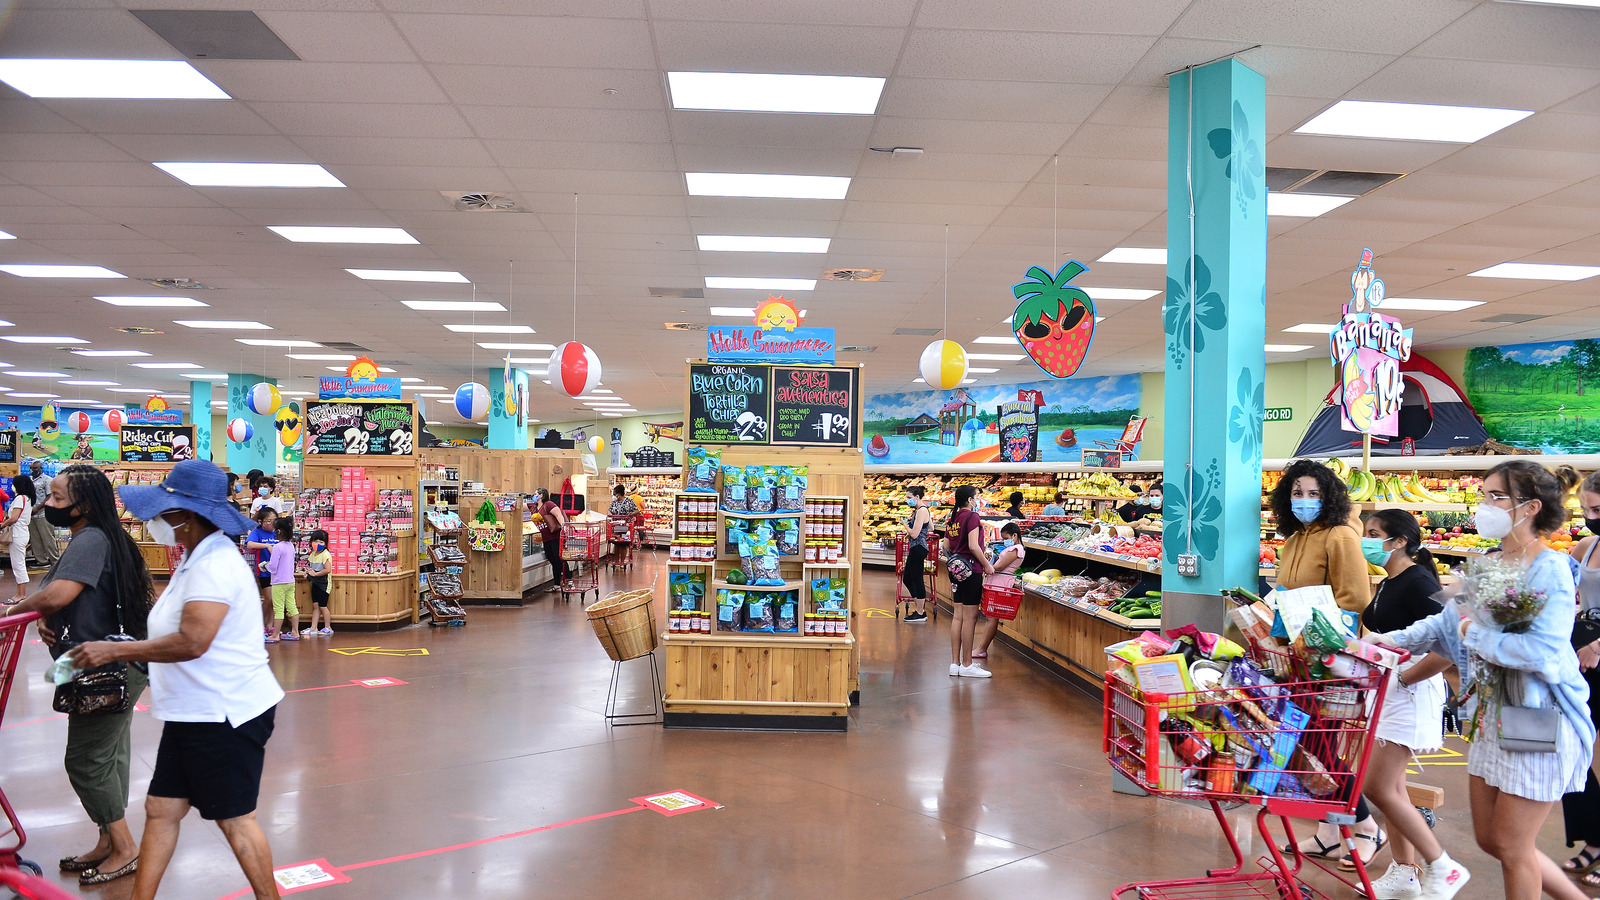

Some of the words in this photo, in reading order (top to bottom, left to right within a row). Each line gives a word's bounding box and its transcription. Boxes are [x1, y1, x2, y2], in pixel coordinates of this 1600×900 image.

[752, 329, 832, 356] Summer!
[1333, 312, 1412, 362] Bananas
[711, 365, 746, 375] ORGANIC
[345, 378, 397, 394] Summer!
[791, 370, 829, 389] Salsa
[307, 403, 363, 425] Neapolitan
[367, 407, 413, 424] Watermelon
[712, 408, 740, 421] CHIPS
[1280, 408, 1291, 420] RD
[122, 429, 153, 443] Ridge
[154, 430, 175, 443] Cut
